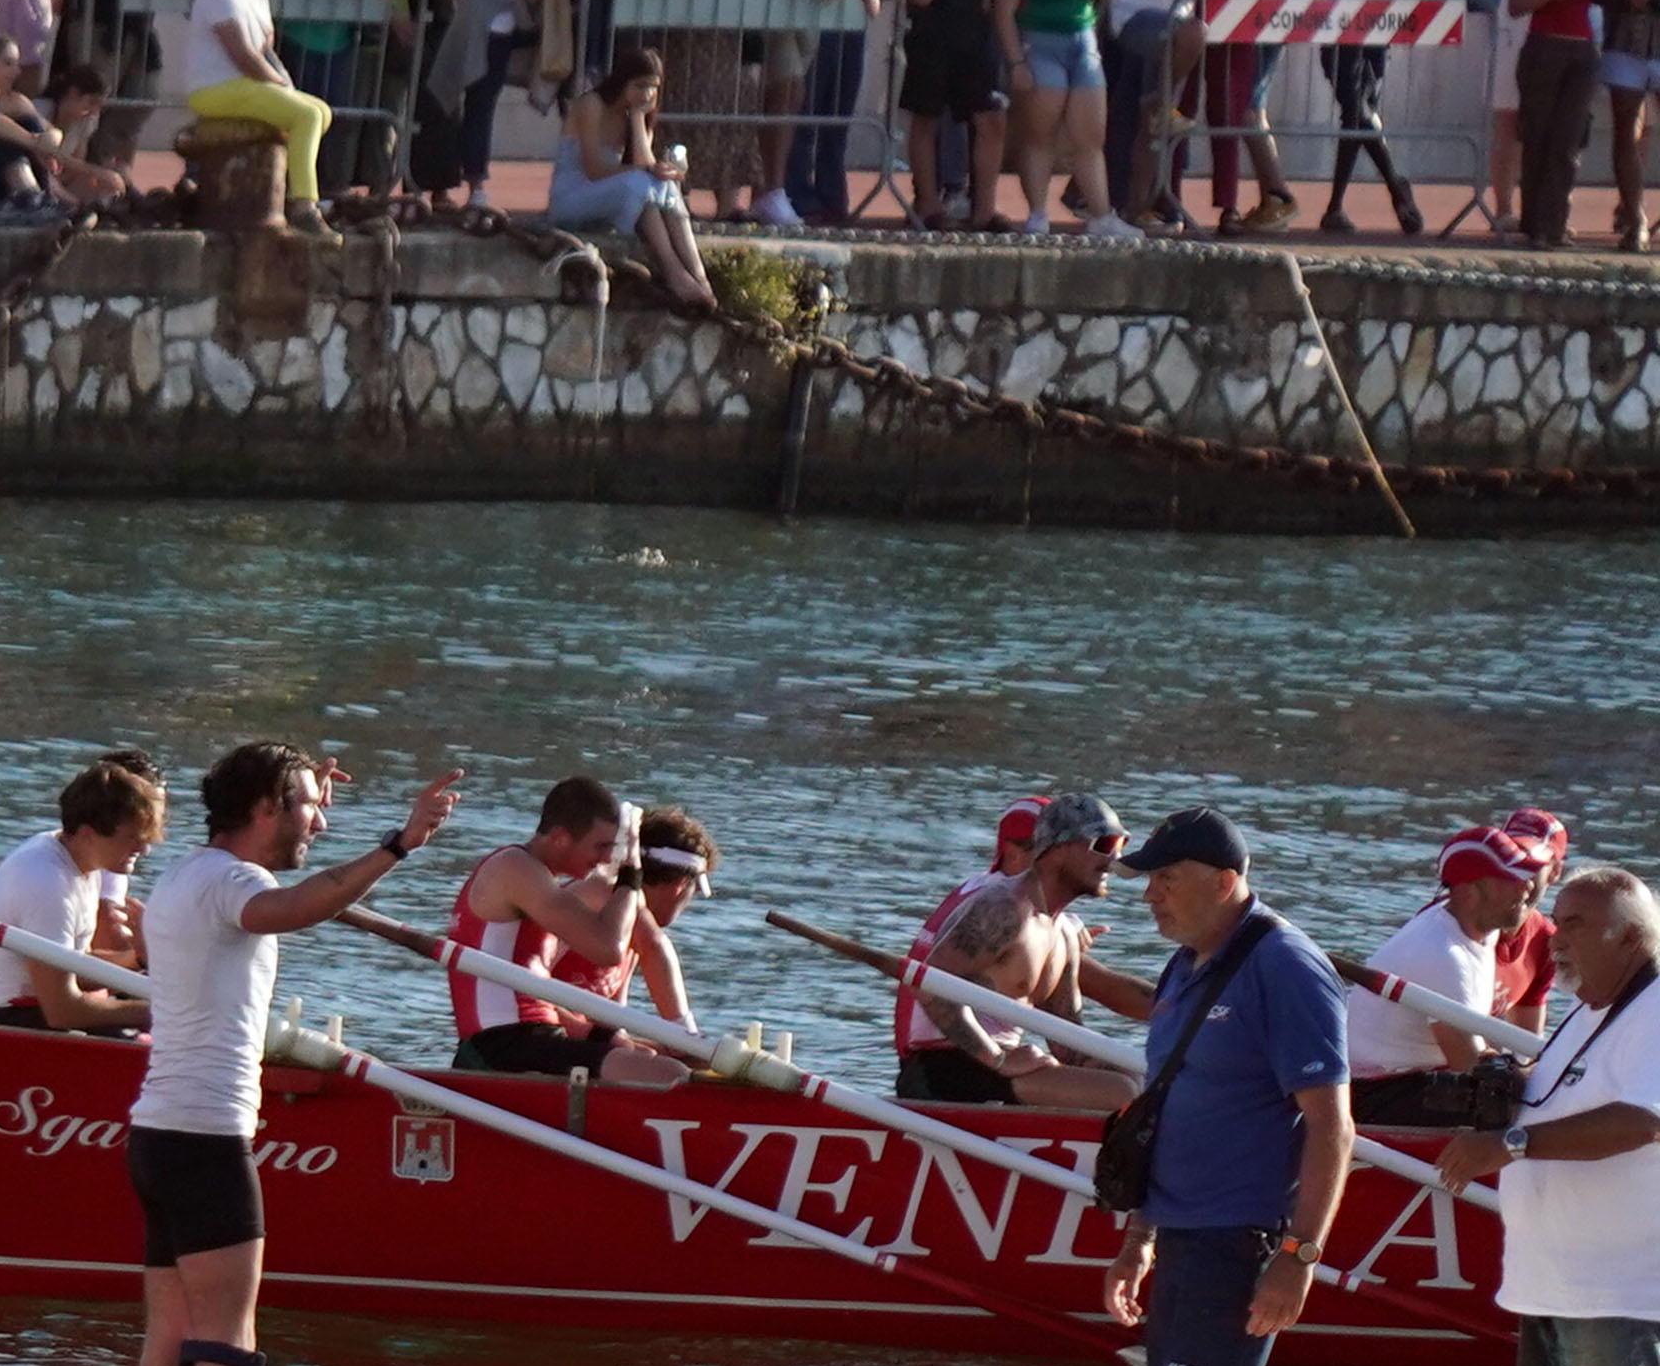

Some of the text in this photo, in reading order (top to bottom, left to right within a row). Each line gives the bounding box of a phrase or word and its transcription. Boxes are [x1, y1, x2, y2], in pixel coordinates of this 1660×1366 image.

[1270, 9, 1334, 32] COMUNE
[1355, 11, 1418, 34] LIVORNO
[643, 1117, 1477, 1292] VENEA
